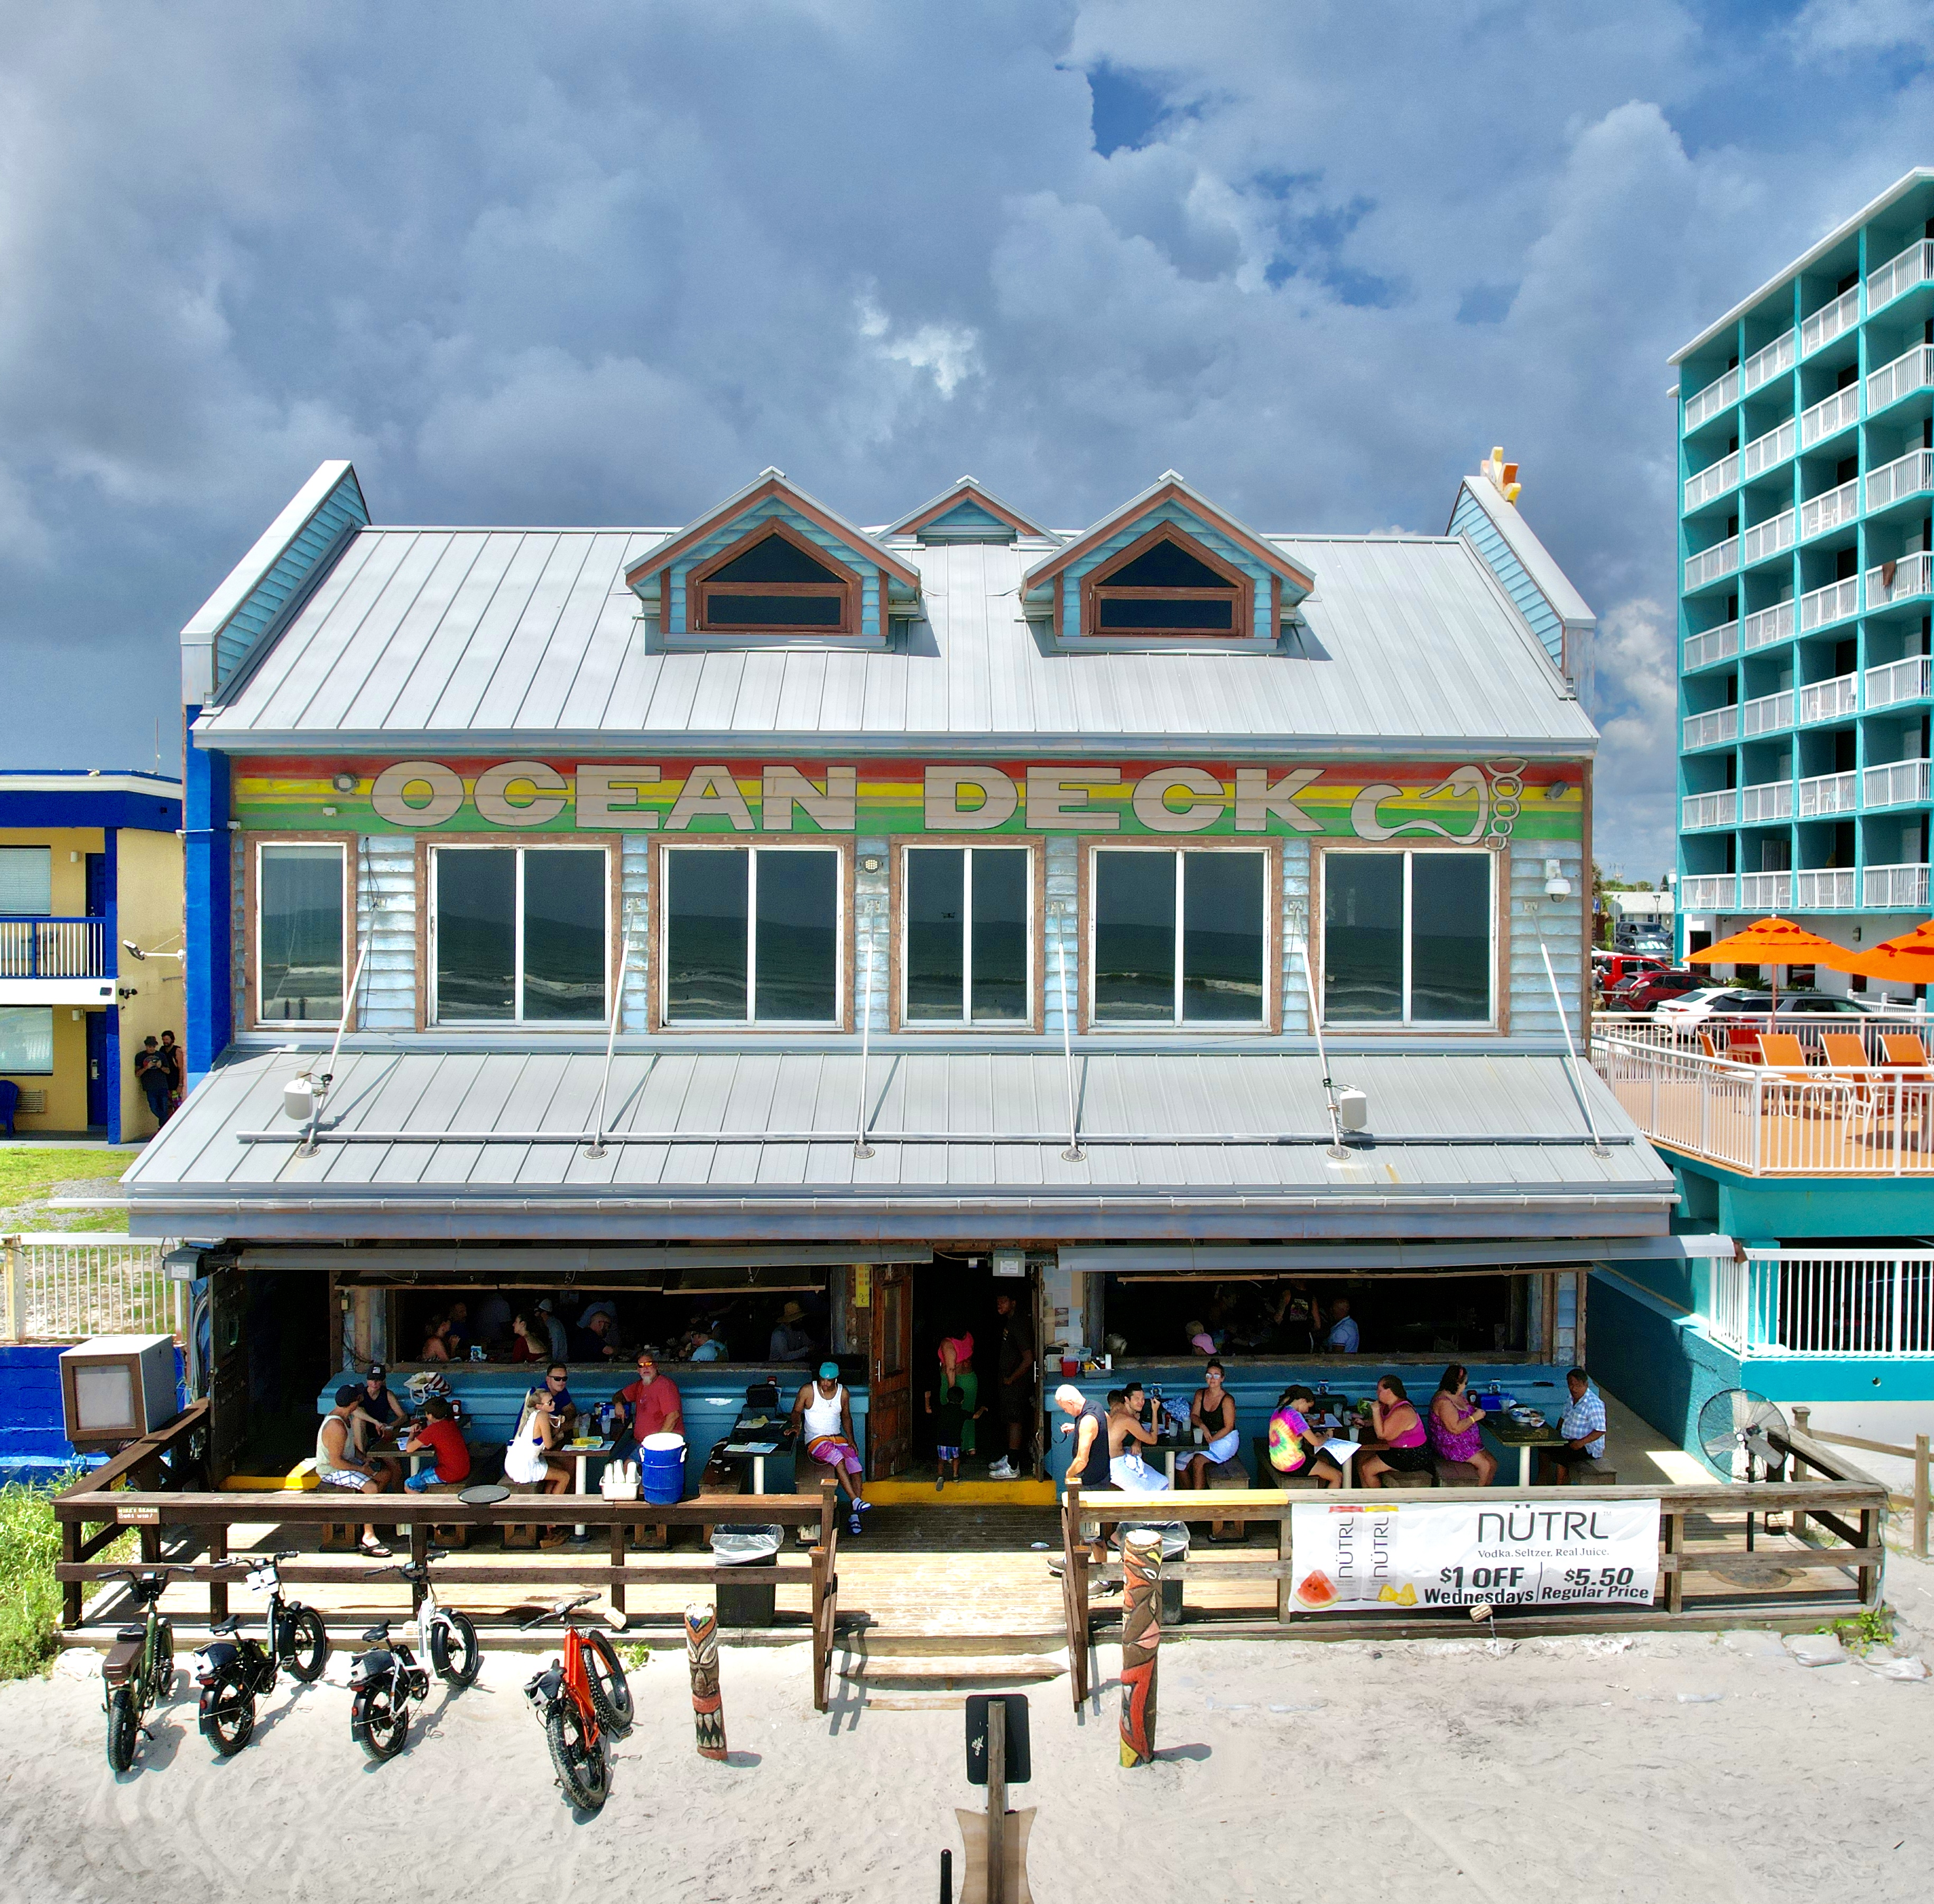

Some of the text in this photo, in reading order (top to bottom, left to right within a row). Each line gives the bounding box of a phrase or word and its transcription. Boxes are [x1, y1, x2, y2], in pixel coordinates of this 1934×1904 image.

[371, 760, 1327, 833] OCEAN DECK
[1515, 1549, 1553, 1557] Seltzer.
[1556, 1548, 1578, 1557] Real
[1579, 1548, 1609, 1556] Juice.
[1440, 1567, 1525, 1588] $1 OFF
[1564, 1568, 1634, 1586] $5.50
[1424, 1588, 1534, 1605] Wednesdays
[1542, 1585, 1649, 1601] Regular Price
